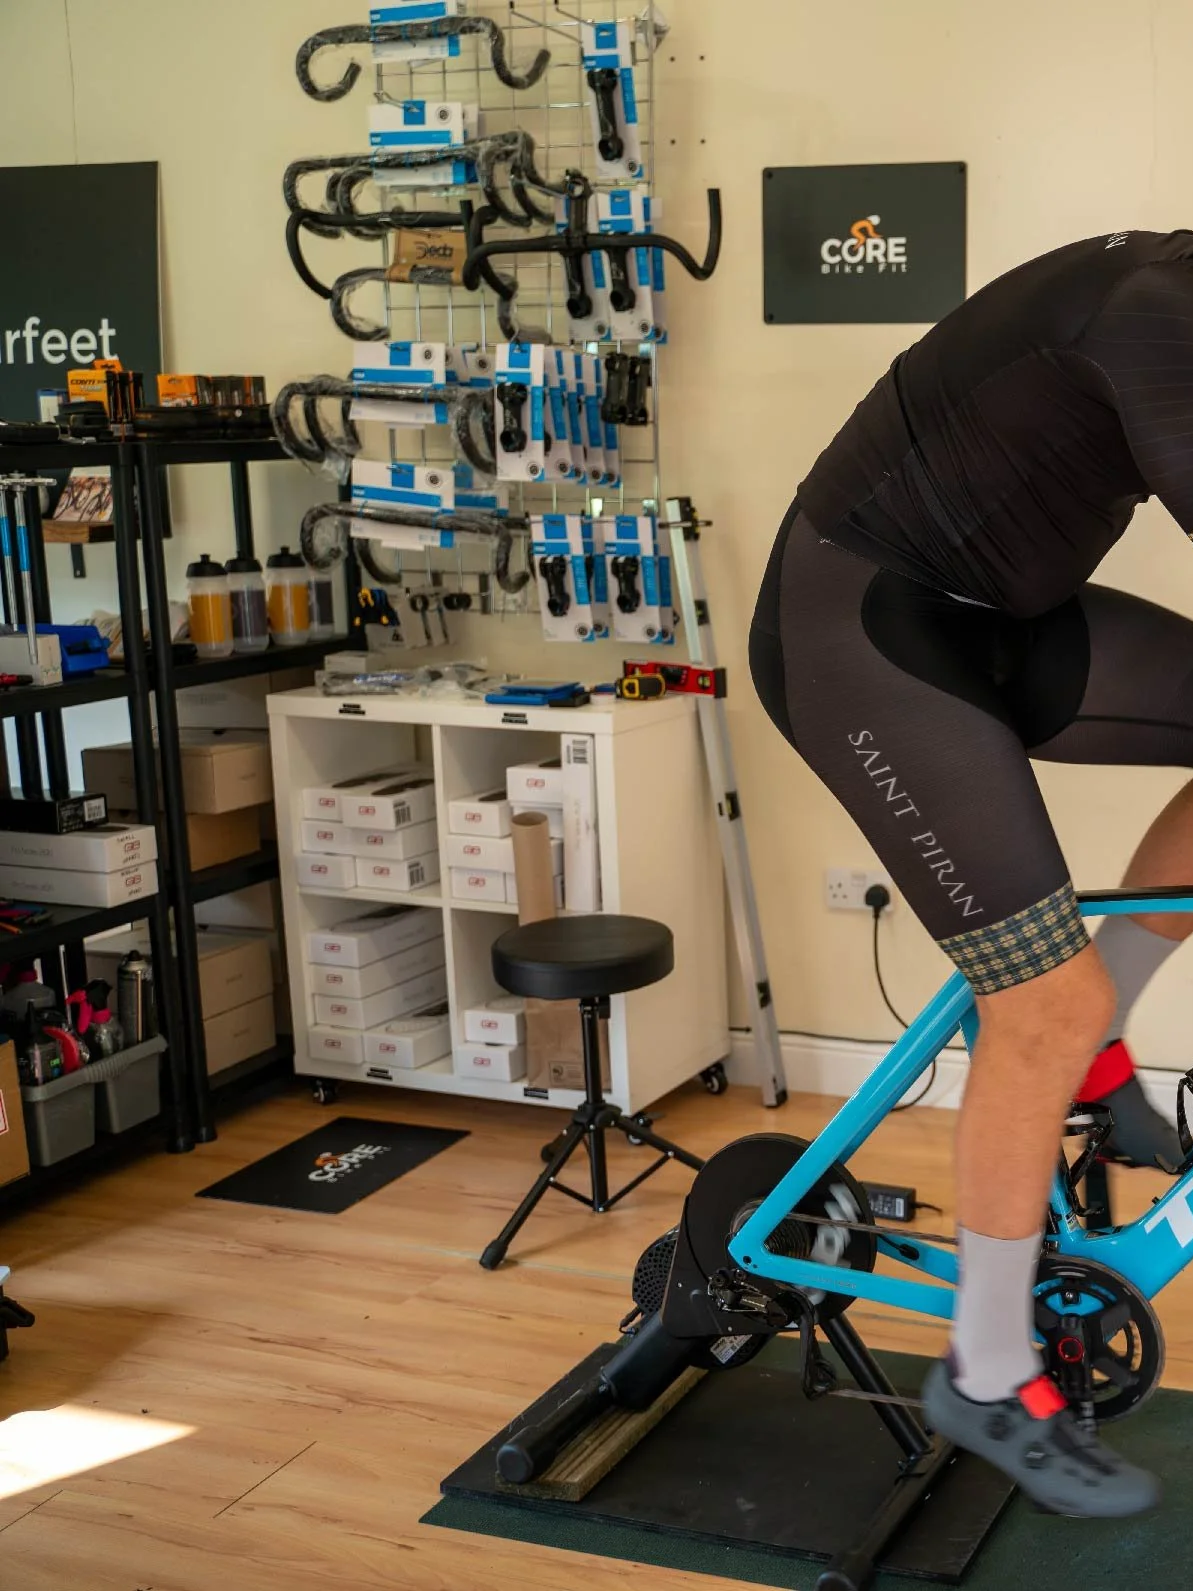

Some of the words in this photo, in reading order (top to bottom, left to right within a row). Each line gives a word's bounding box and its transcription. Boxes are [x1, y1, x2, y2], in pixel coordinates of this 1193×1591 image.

[820, 237, 907, 264] CORE
[821, 264, 864, 274] Bike
[879, 263, 907, 273] Fit
[0, 316, 119, 365] rfeet
[848, 730, 920, 817] SAINT
[911, 830, 983, 917] PIRAN
